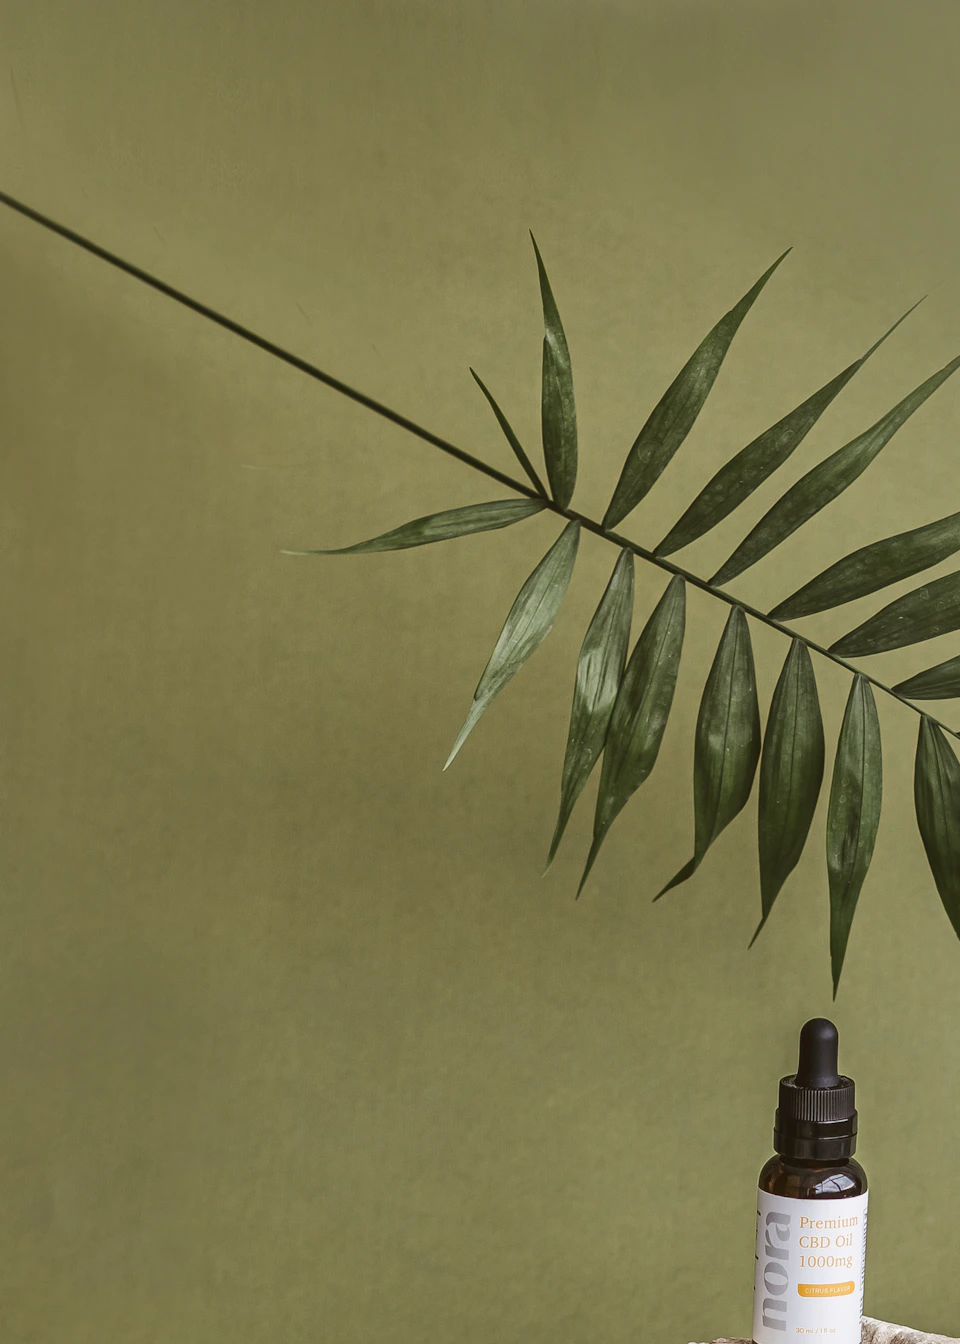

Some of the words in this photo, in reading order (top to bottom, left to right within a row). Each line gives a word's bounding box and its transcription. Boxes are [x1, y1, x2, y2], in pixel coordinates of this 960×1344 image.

[800, 1215, 858, 1229] Premium
[800, 1236, 830, 1249] CBD
[835, 1233, 853, 1247] Oil
[800, 1255, 852, 1268] 1000mg
[763, 1211, 791, 1331] nora
[830, 1285, 850, 1293] FLAVOR
